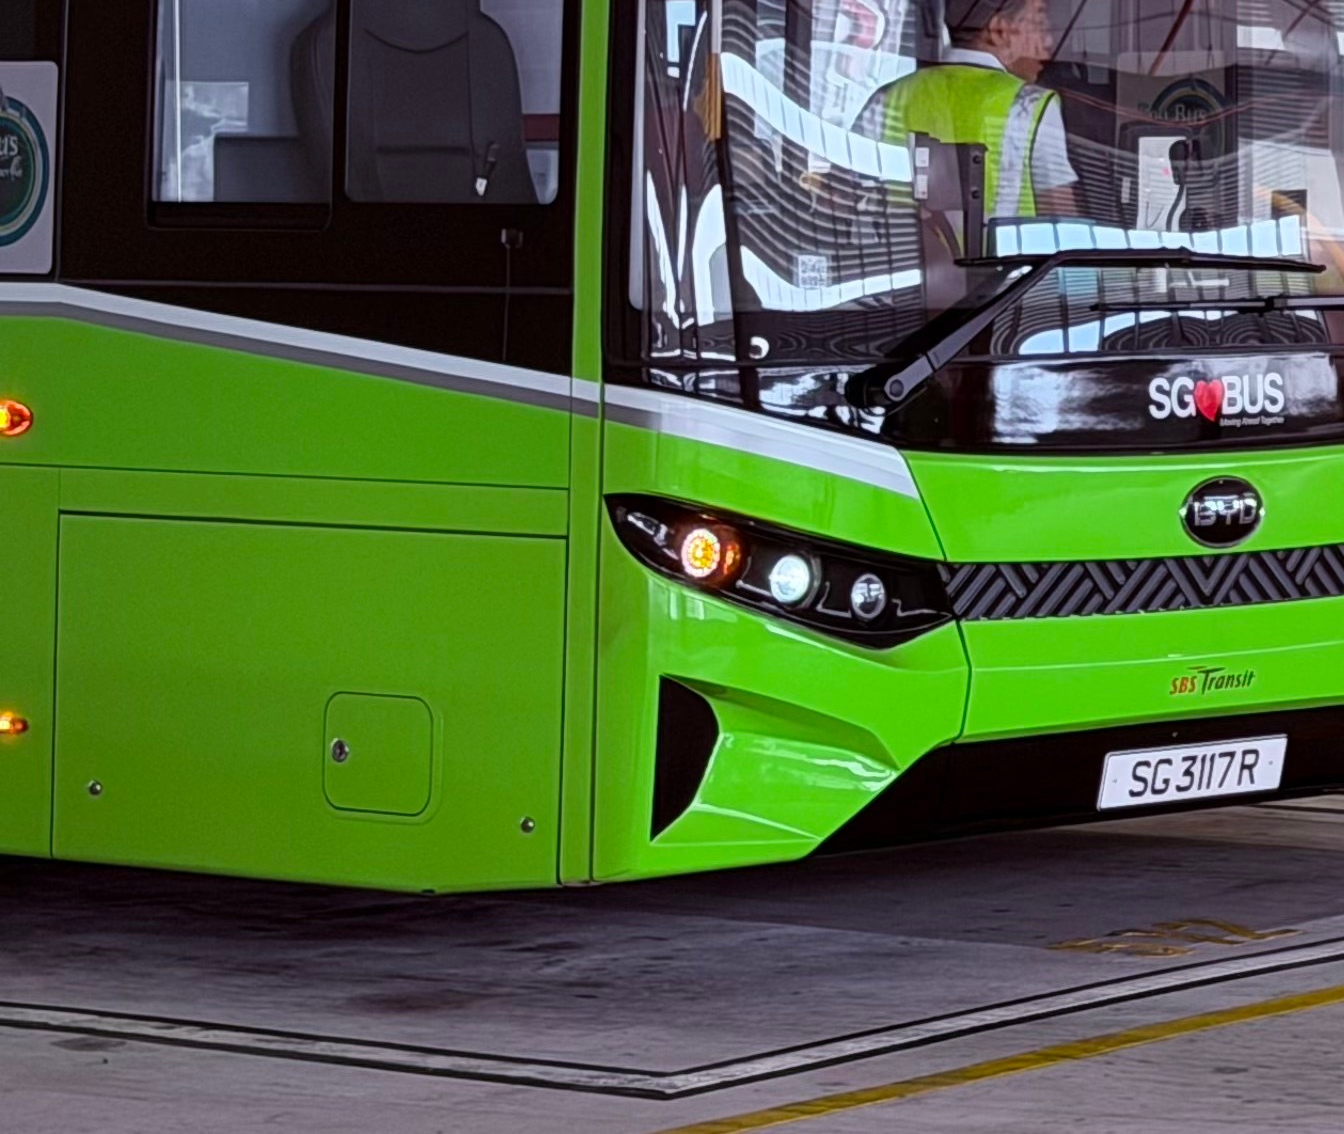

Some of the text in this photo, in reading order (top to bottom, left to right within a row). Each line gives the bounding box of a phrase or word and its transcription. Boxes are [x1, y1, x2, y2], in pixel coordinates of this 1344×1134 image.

[1149, 372, 1285, 419] SG BUS
[1194, 495, 1257, 527] BYD
[1170, 667, 1256, 696] SBS Transit
[1128, 748, 1260, 798] SG3117R
